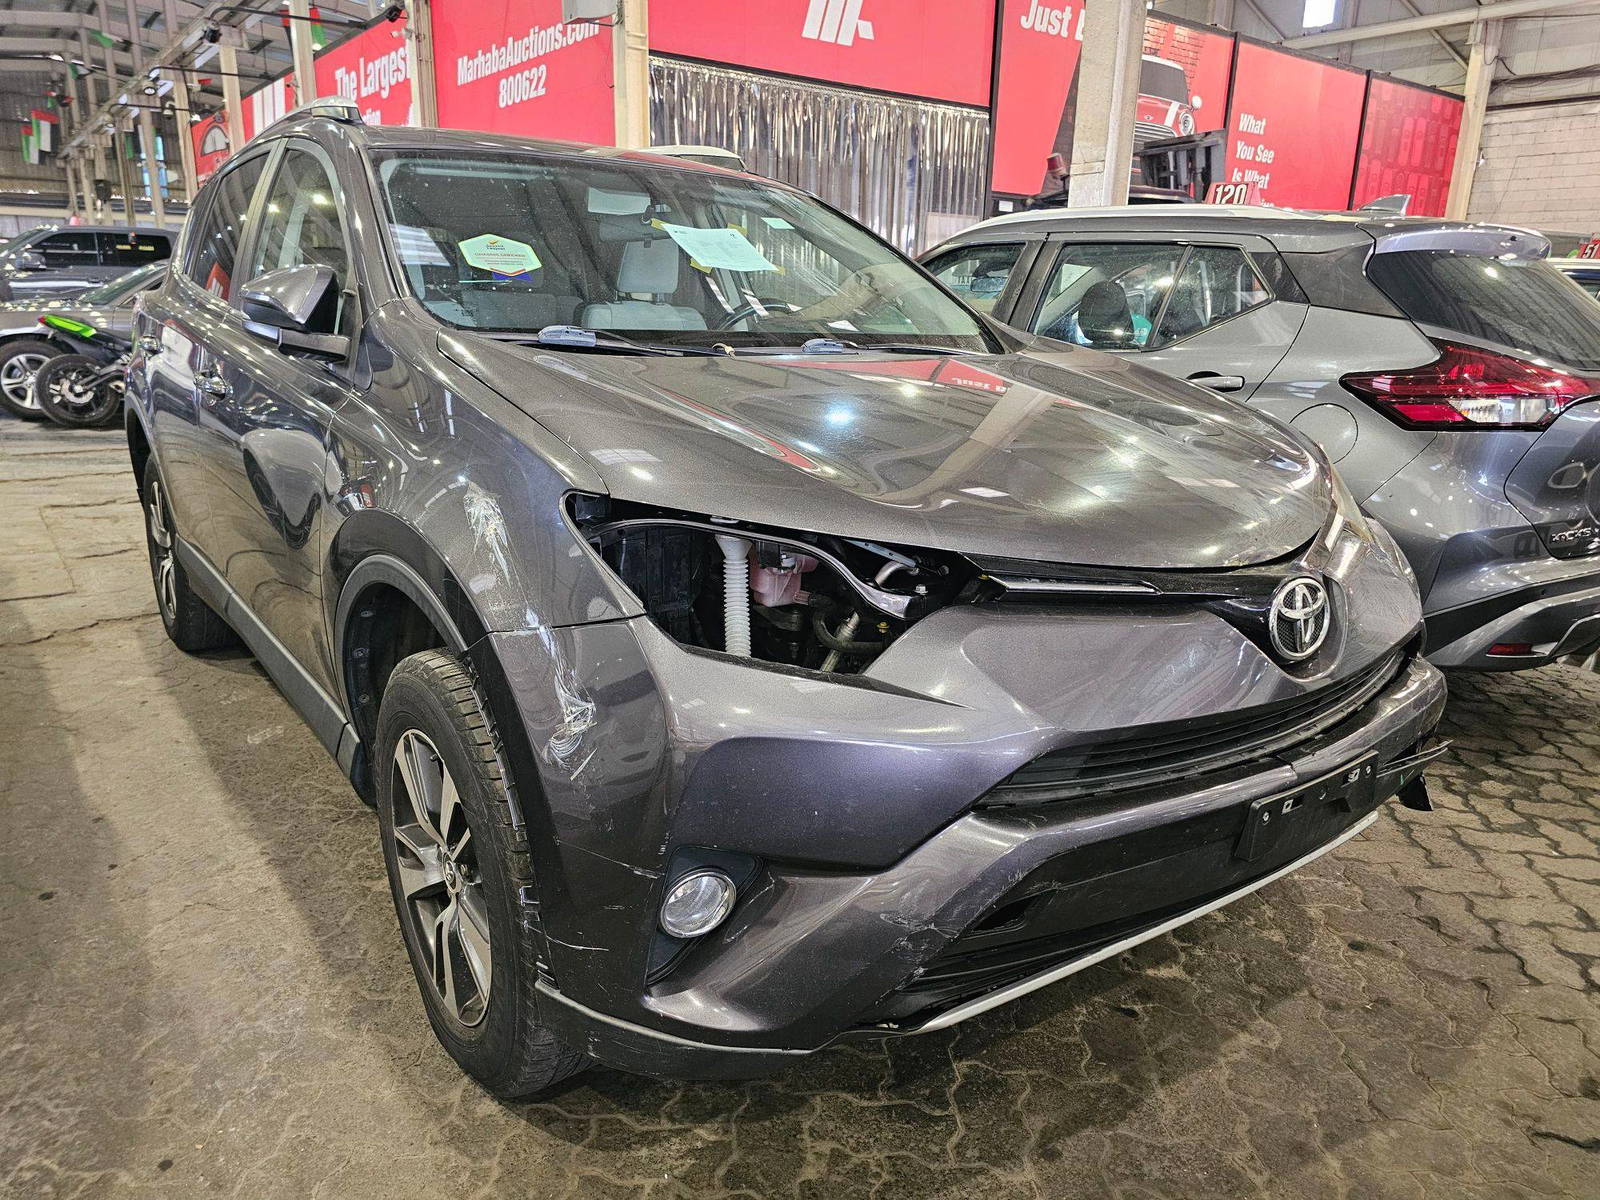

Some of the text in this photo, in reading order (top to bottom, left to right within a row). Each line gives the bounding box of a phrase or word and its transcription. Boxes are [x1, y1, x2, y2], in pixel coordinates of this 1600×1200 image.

[1020, 0, 1072, 38] Just
[457, 20, 600, 86] MarhabaAuctions.com
[335, 66, 358, 101] The
[498, 64, 547, 108] 800622
[1238, 113, 1266, 135] What
[1235, 140, 1275, 164] You See
[1214, 184, 1247, 205] 120
[1582, 243, 1600, 259] 51
